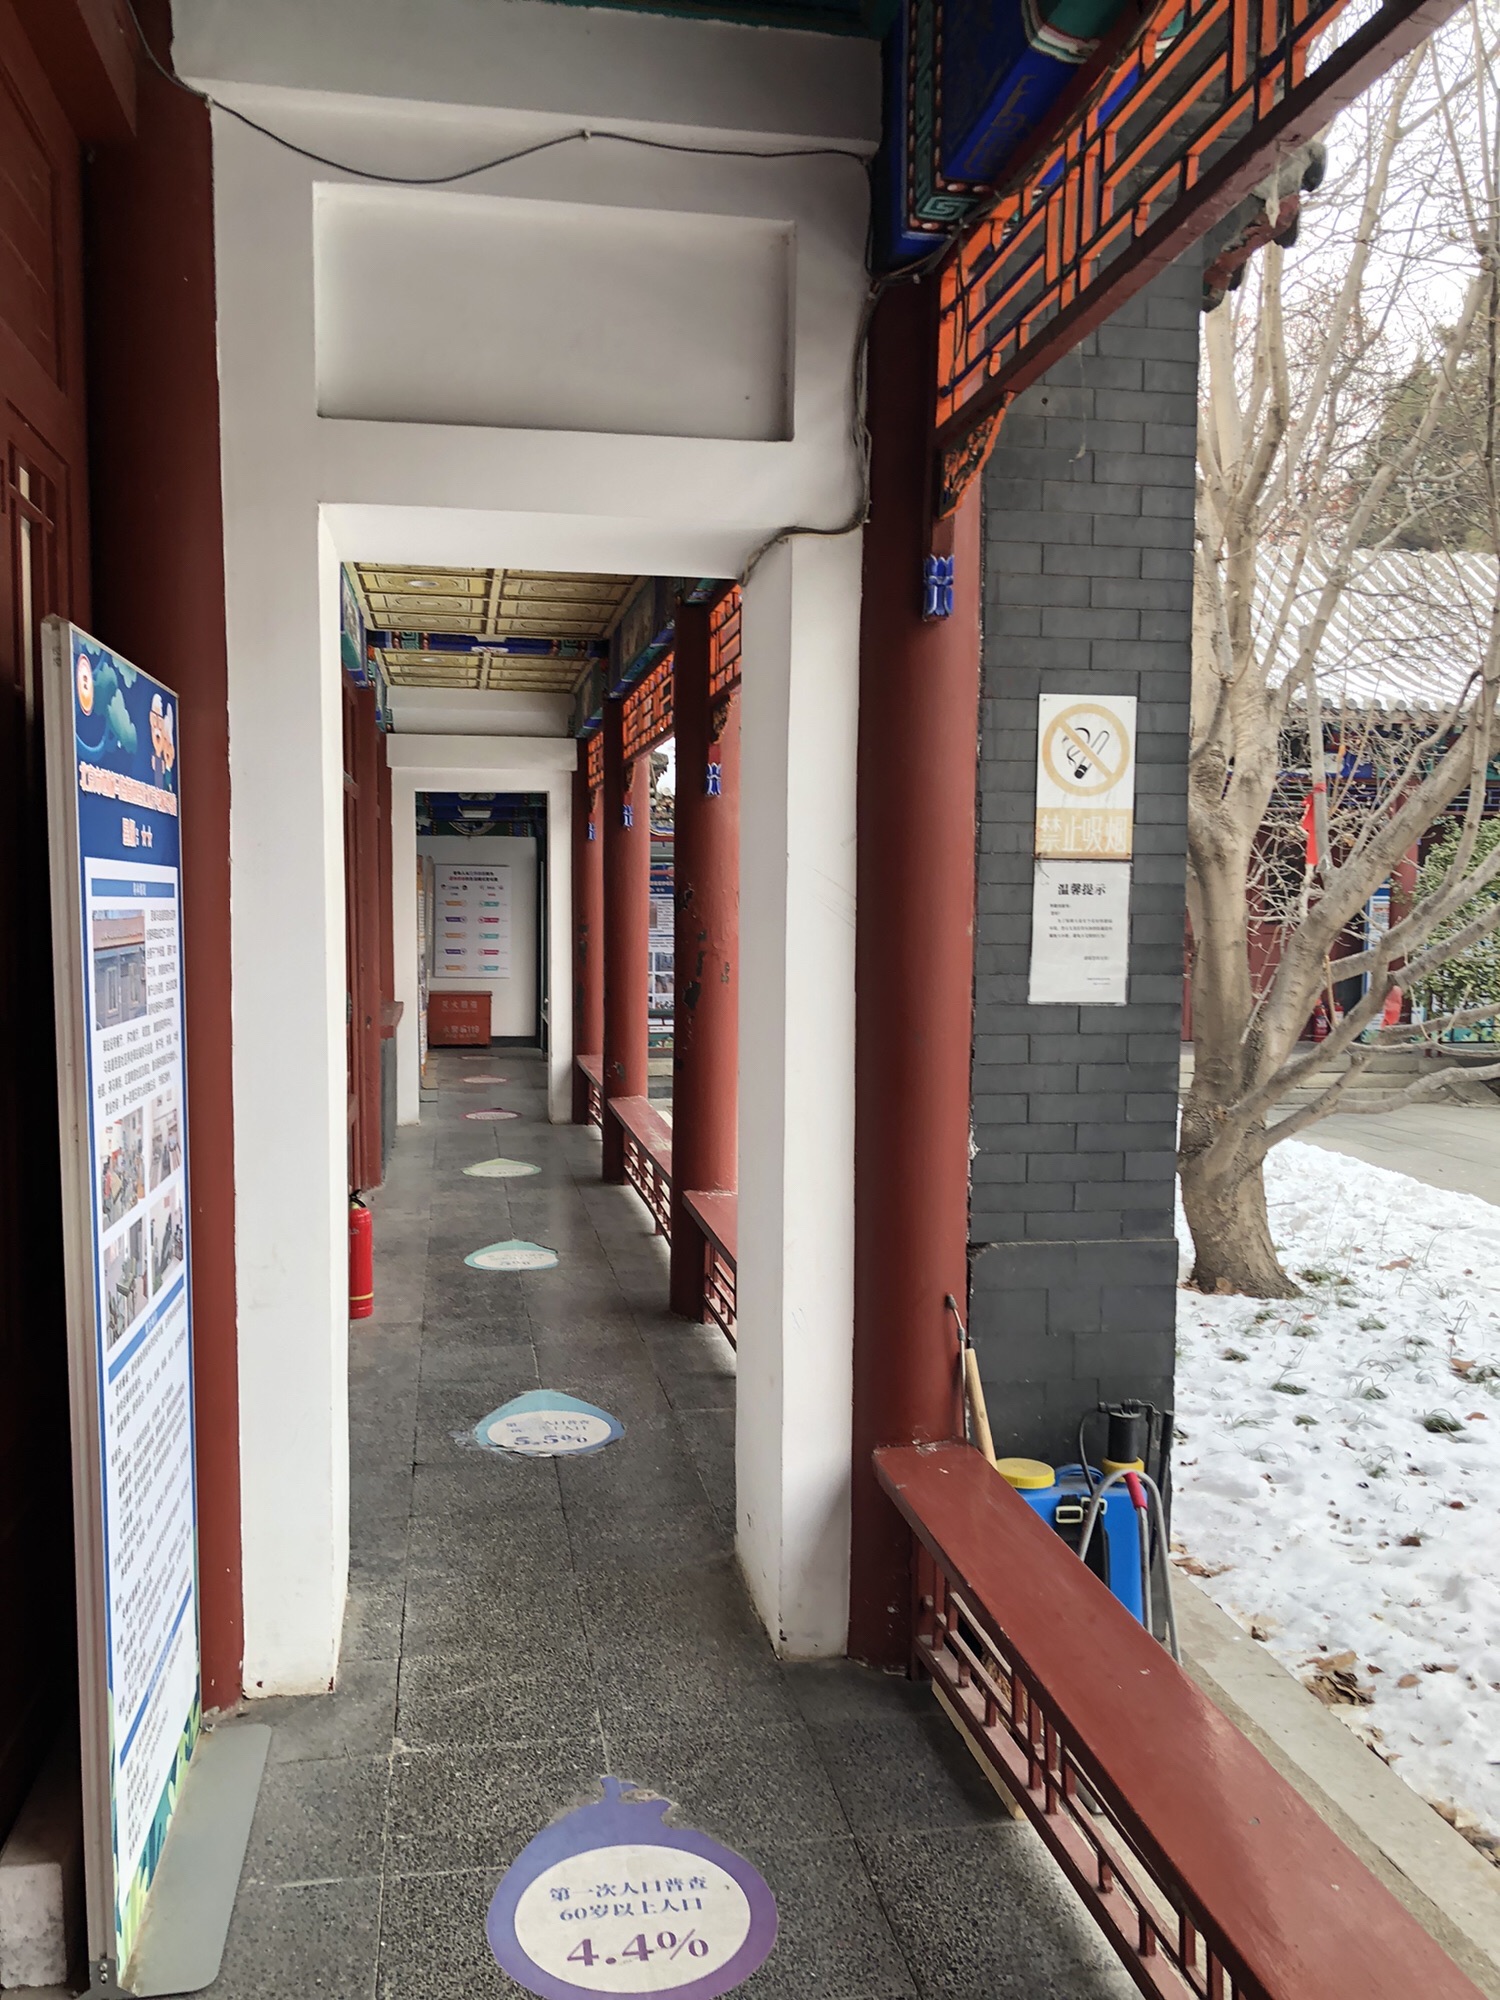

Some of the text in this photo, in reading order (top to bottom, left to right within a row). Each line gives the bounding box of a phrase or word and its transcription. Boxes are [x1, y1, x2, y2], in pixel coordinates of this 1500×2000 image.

[1039, 814, 1127, 853] 禁止吸烟
[1057, 883, 1106, 896] 温馨提示
[514, 1433, 588, 1446] 5.5%
[549, 1875, 709, 1903] 第一次人口普查
[559, 1896, 703, 1922] 60岁以上人口
[566, 1928, 710, 1968] 4.4%
